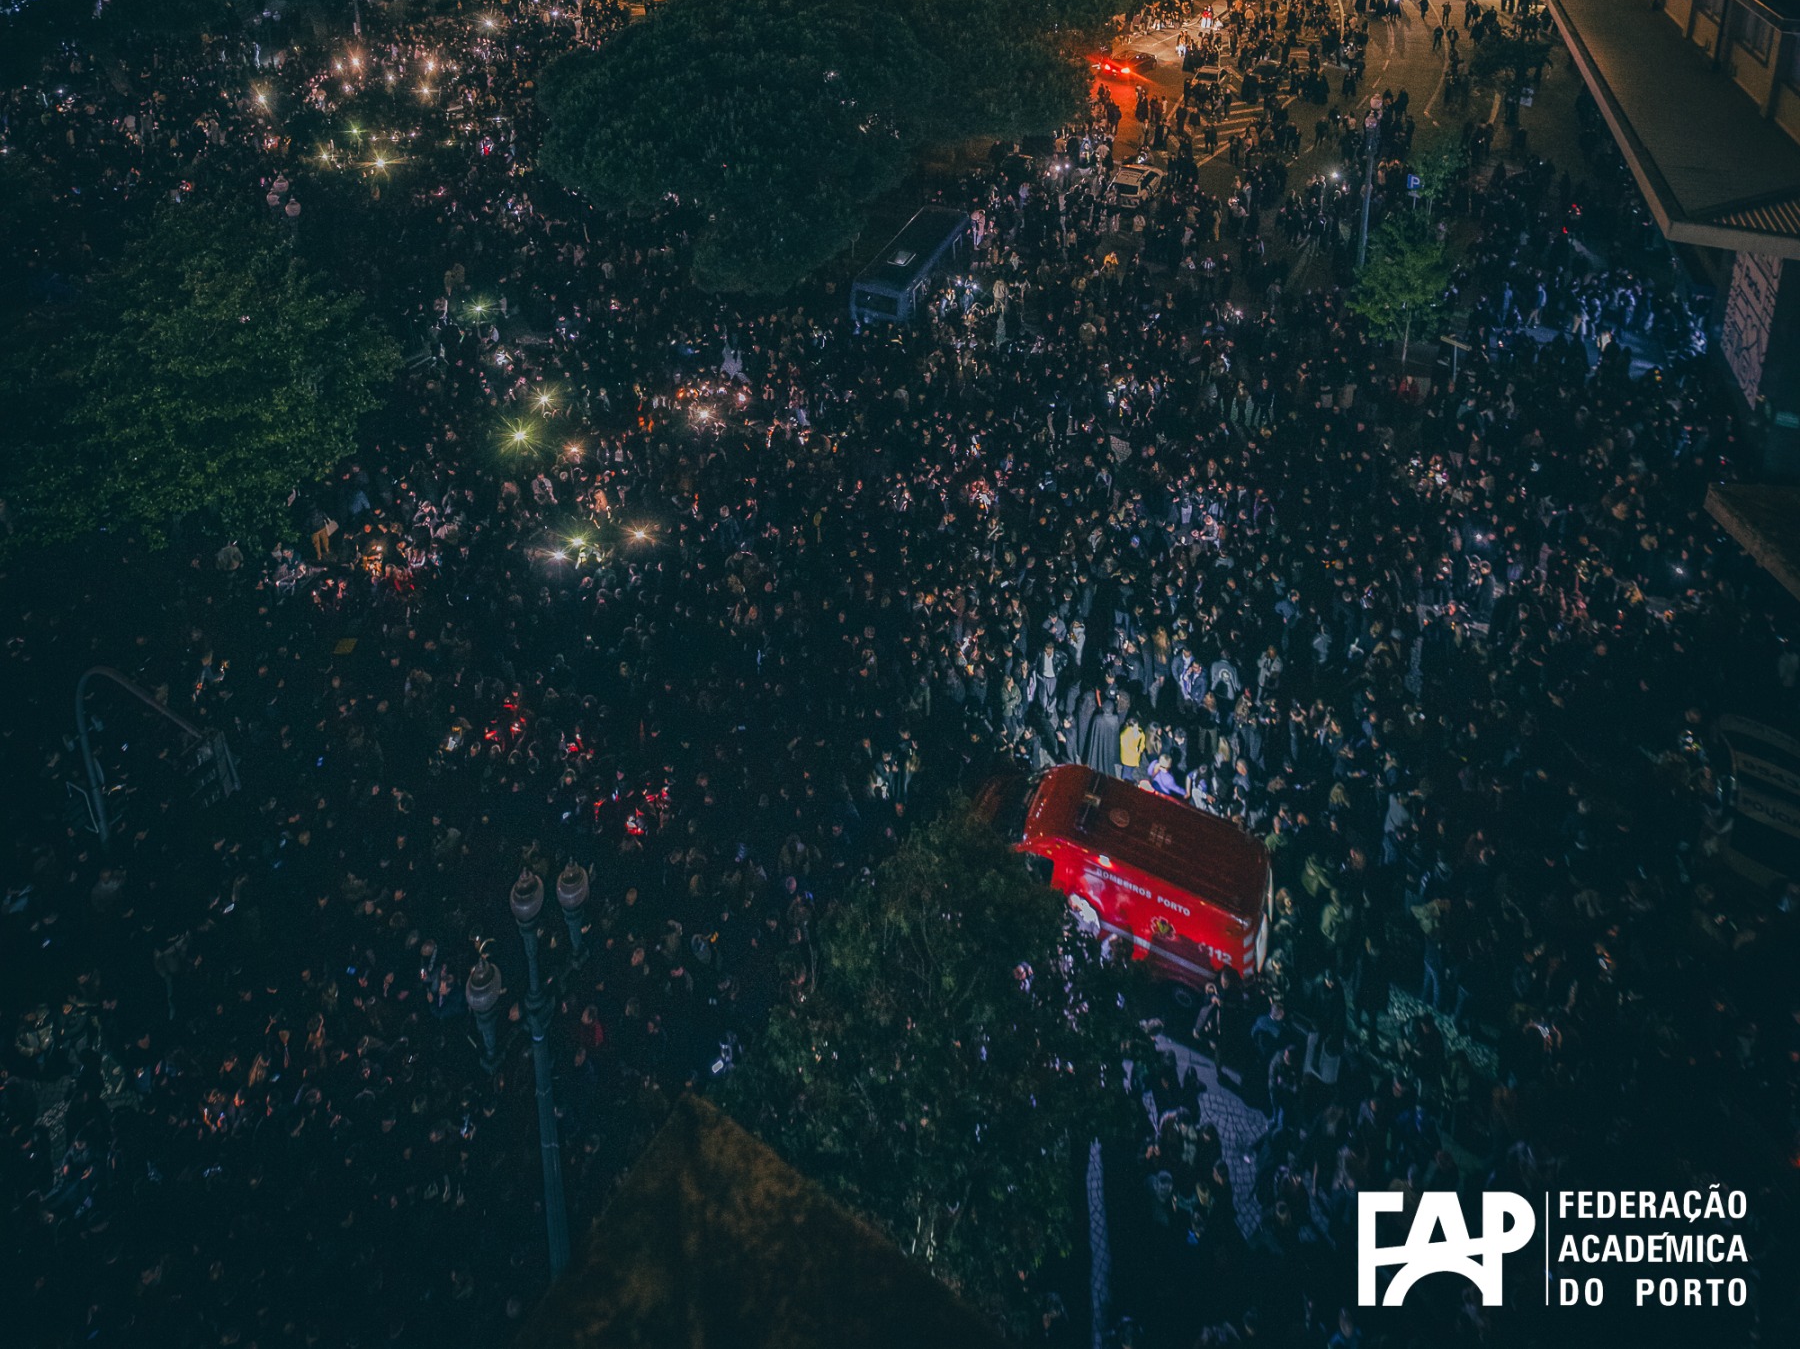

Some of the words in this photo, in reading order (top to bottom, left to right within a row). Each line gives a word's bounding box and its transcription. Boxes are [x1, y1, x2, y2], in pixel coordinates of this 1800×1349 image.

[1410, 175, 1421, 188] P
[1096, 868, 1152, 899] BOMBEIROS
[1157, 895, 1191, 917] PORTO
[1208, 945, 1233, 966] 112
